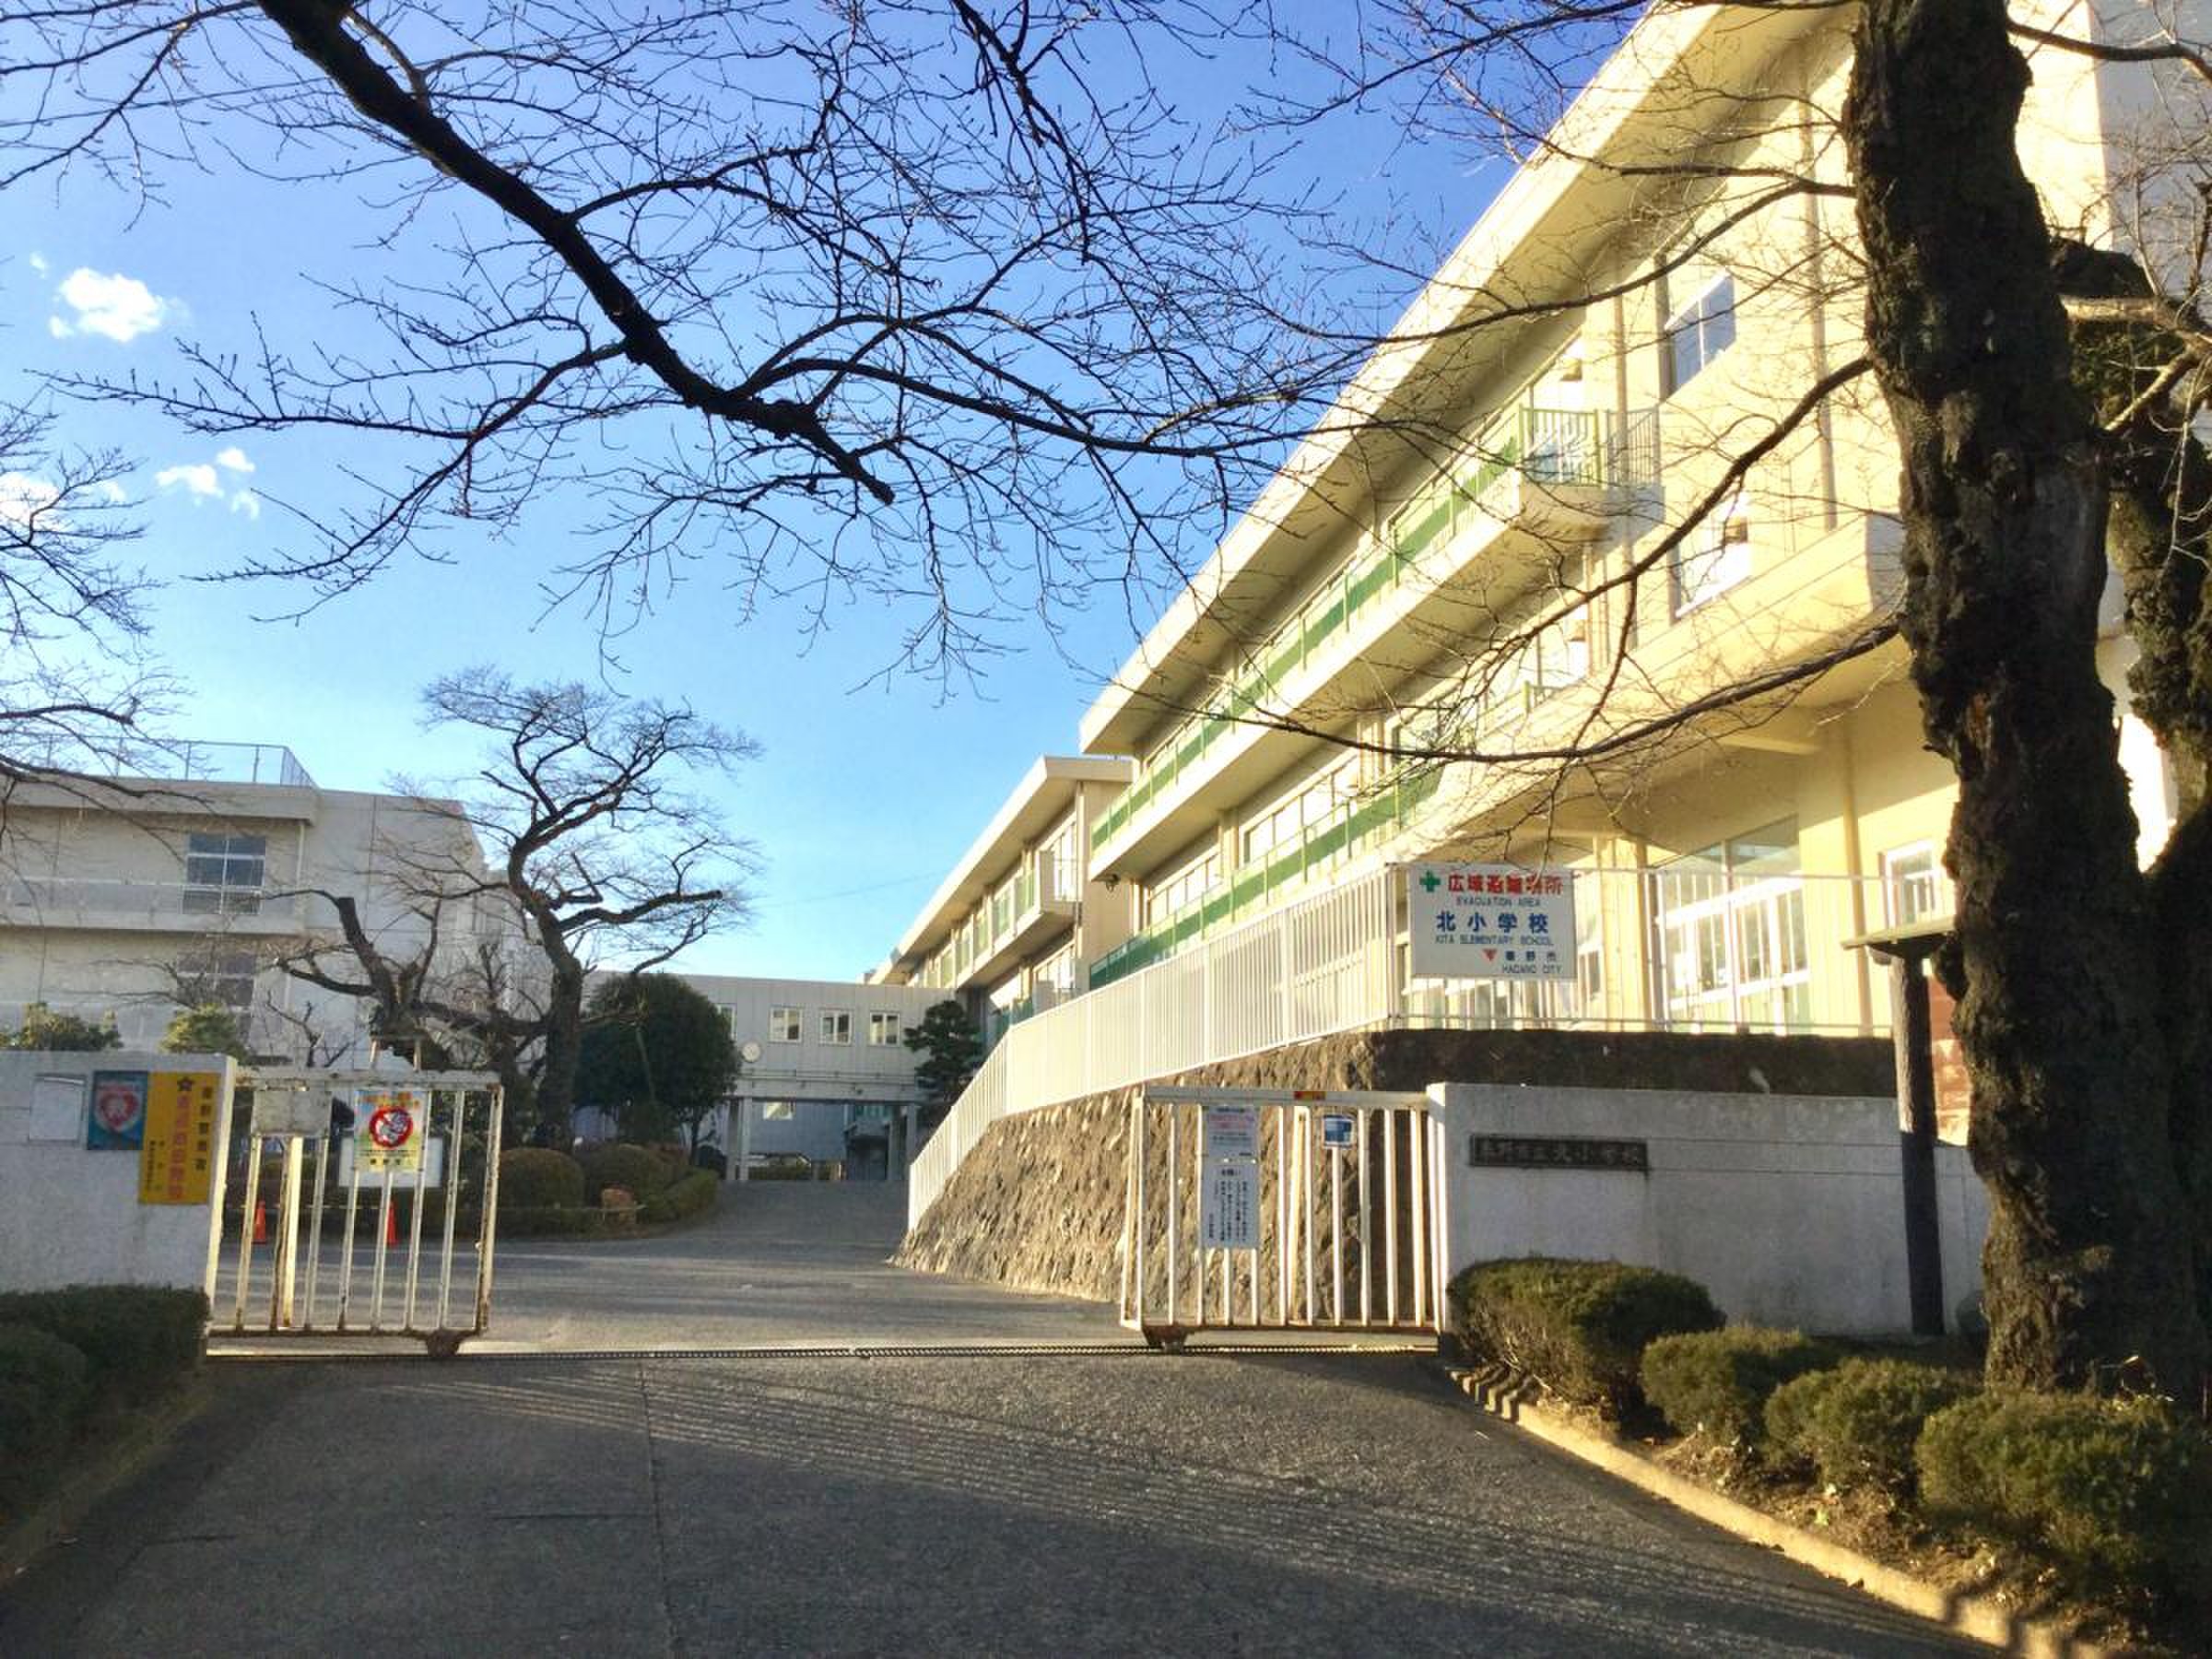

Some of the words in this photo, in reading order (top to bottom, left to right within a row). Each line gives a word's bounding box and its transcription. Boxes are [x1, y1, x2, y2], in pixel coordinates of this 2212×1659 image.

[1519, 897, 1541, 907] AREA
[1436, 911, 1549, 934] 北小学校
[1435, 934, 1454, 945] KITA
[1459, 935, 1515, 945] ELEMENTARY
[1520, 935, 1554, 946] SCHOOL
